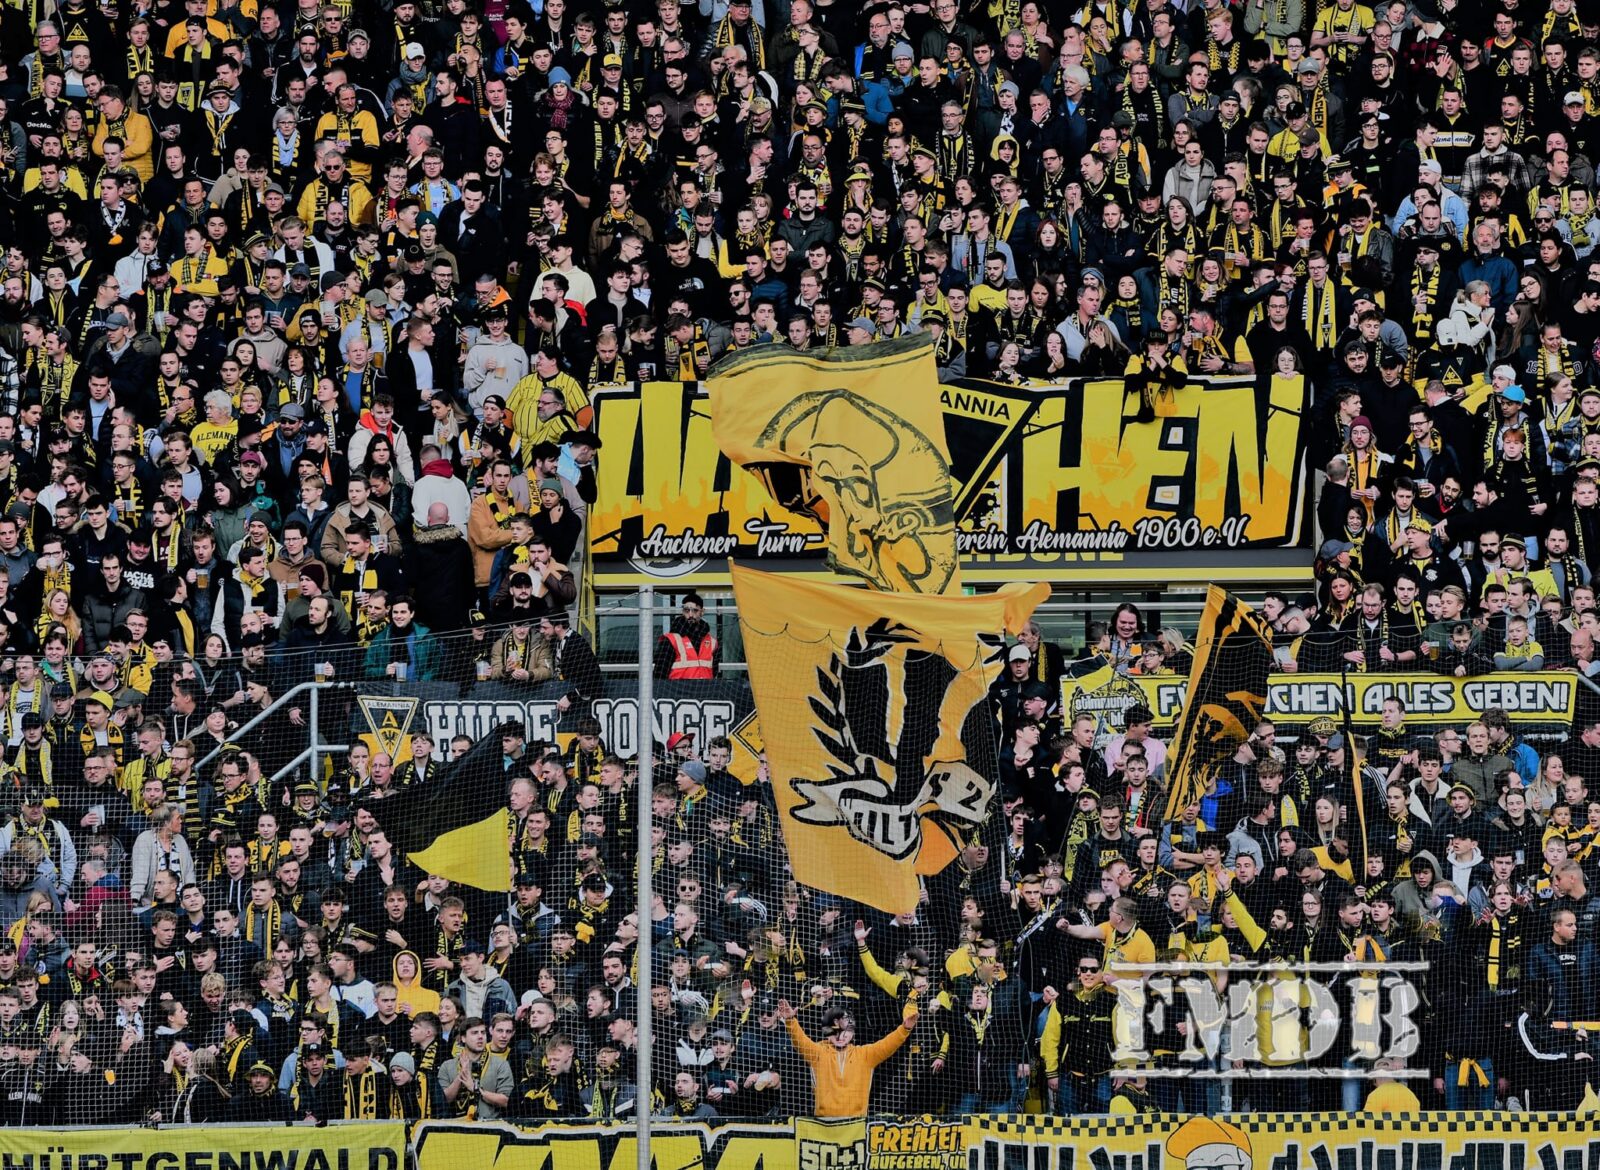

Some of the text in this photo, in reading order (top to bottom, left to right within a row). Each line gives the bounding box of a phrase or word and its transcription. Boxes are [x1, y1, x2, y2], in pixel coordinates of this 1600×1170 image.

[641, 513, 1249, 557] Aachener Turn- erein Alemannia 1900 e.V.
[1363, 682, 1455, 713] ALLES
[1462, 681, 1569, 714] GEBEN!
